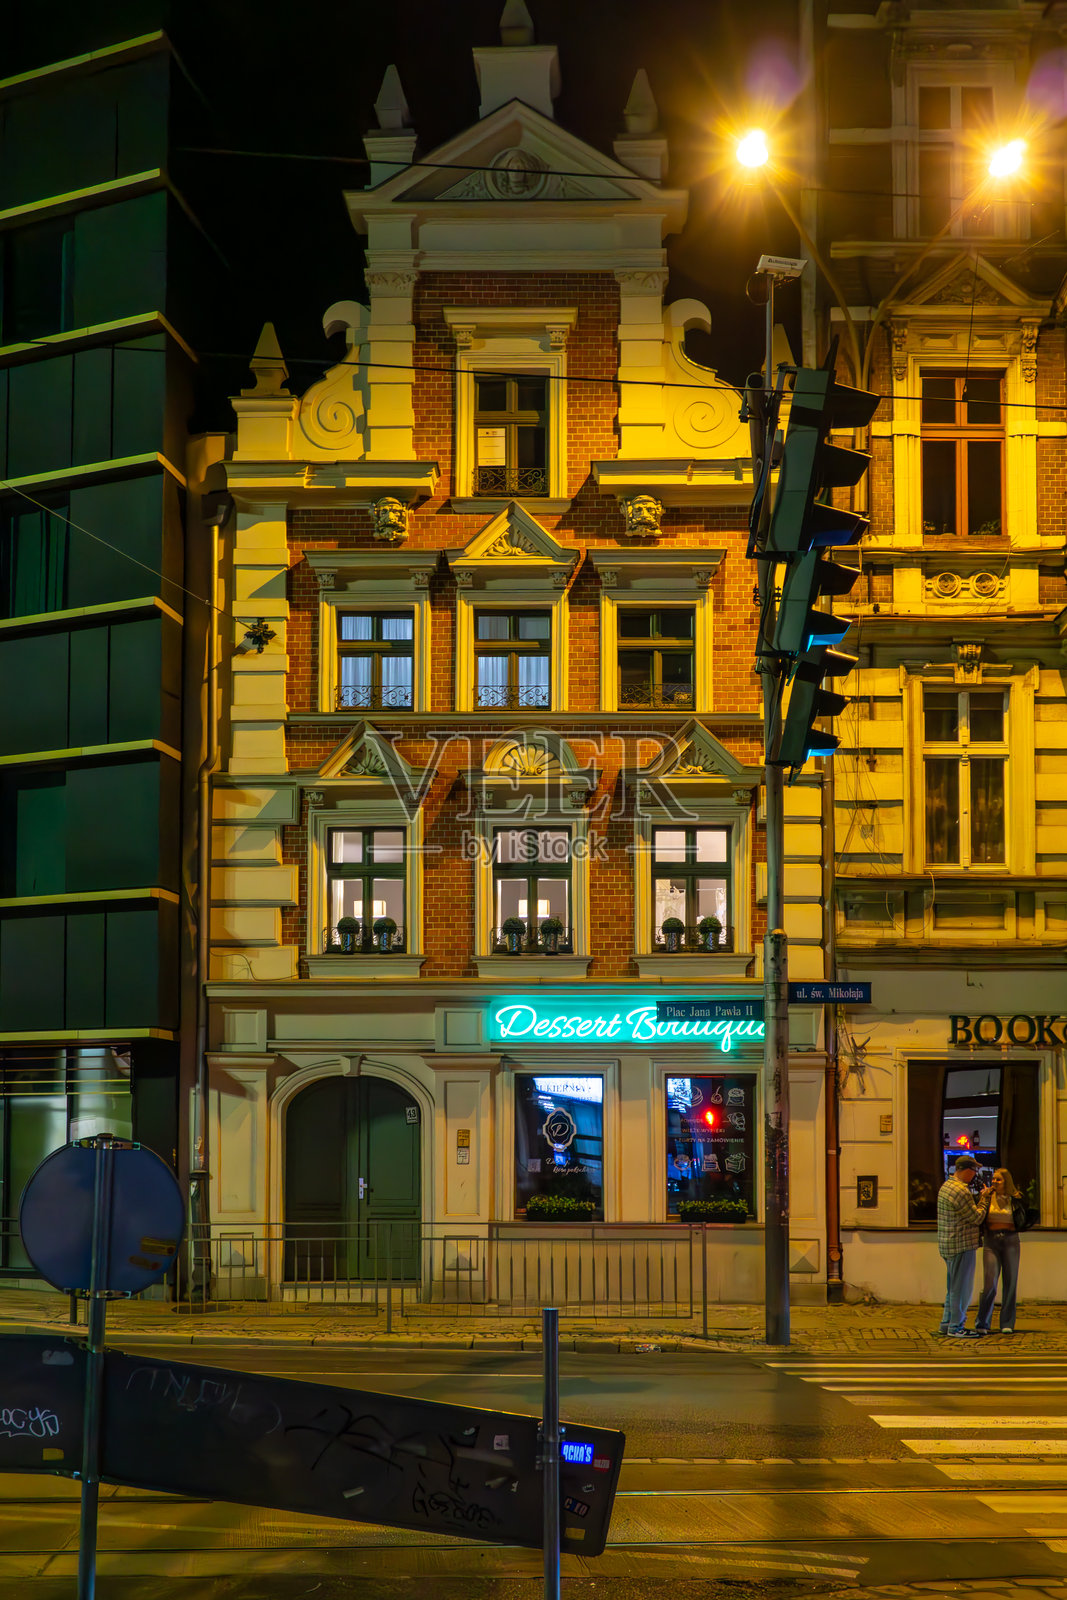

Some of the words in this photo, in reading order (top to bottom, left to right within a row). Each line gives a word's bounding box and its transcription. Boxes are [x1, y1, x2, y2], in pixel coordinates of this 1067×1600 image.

[796, 987, 808, 999] ul.
[810, 987, 825, 999] św.
[828, 987, 864, 1001] Mikołaja
[495, 1004, 623, 1038] Dessert
[666, 1006, 686, 1017] Plac
[690, 1006, 711, 1017] Jana
[715, 1005, 742, 1017] Pawła
[948, 1014, 1067, 1046] BOOK
